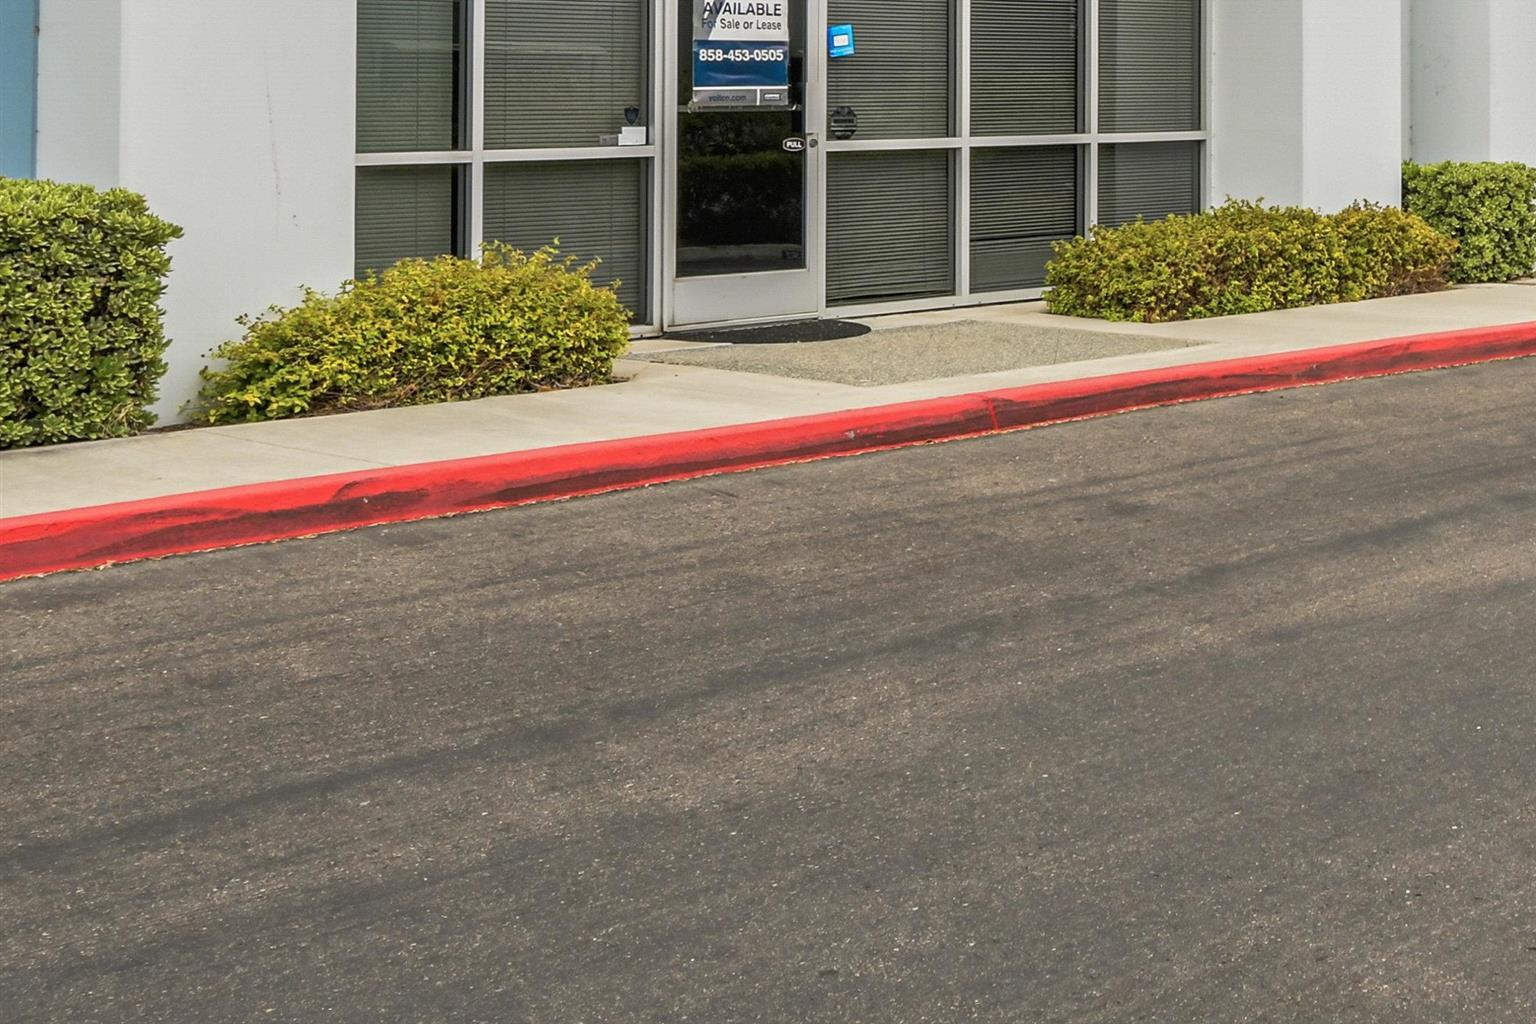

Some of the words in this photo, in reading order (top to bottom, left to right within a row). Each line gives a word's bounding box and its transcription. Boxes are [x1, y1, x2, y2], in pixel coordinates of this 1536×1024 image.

[702, 1, 782, 17] AVAILABLE
[701, 18, 717, 29] For
[720, 18, 740, 29] Sale
[743, 20, 753, 29] or
[756, 19, 782, 31] Lease
[699, 48, 784, 62] 858-453-0505
